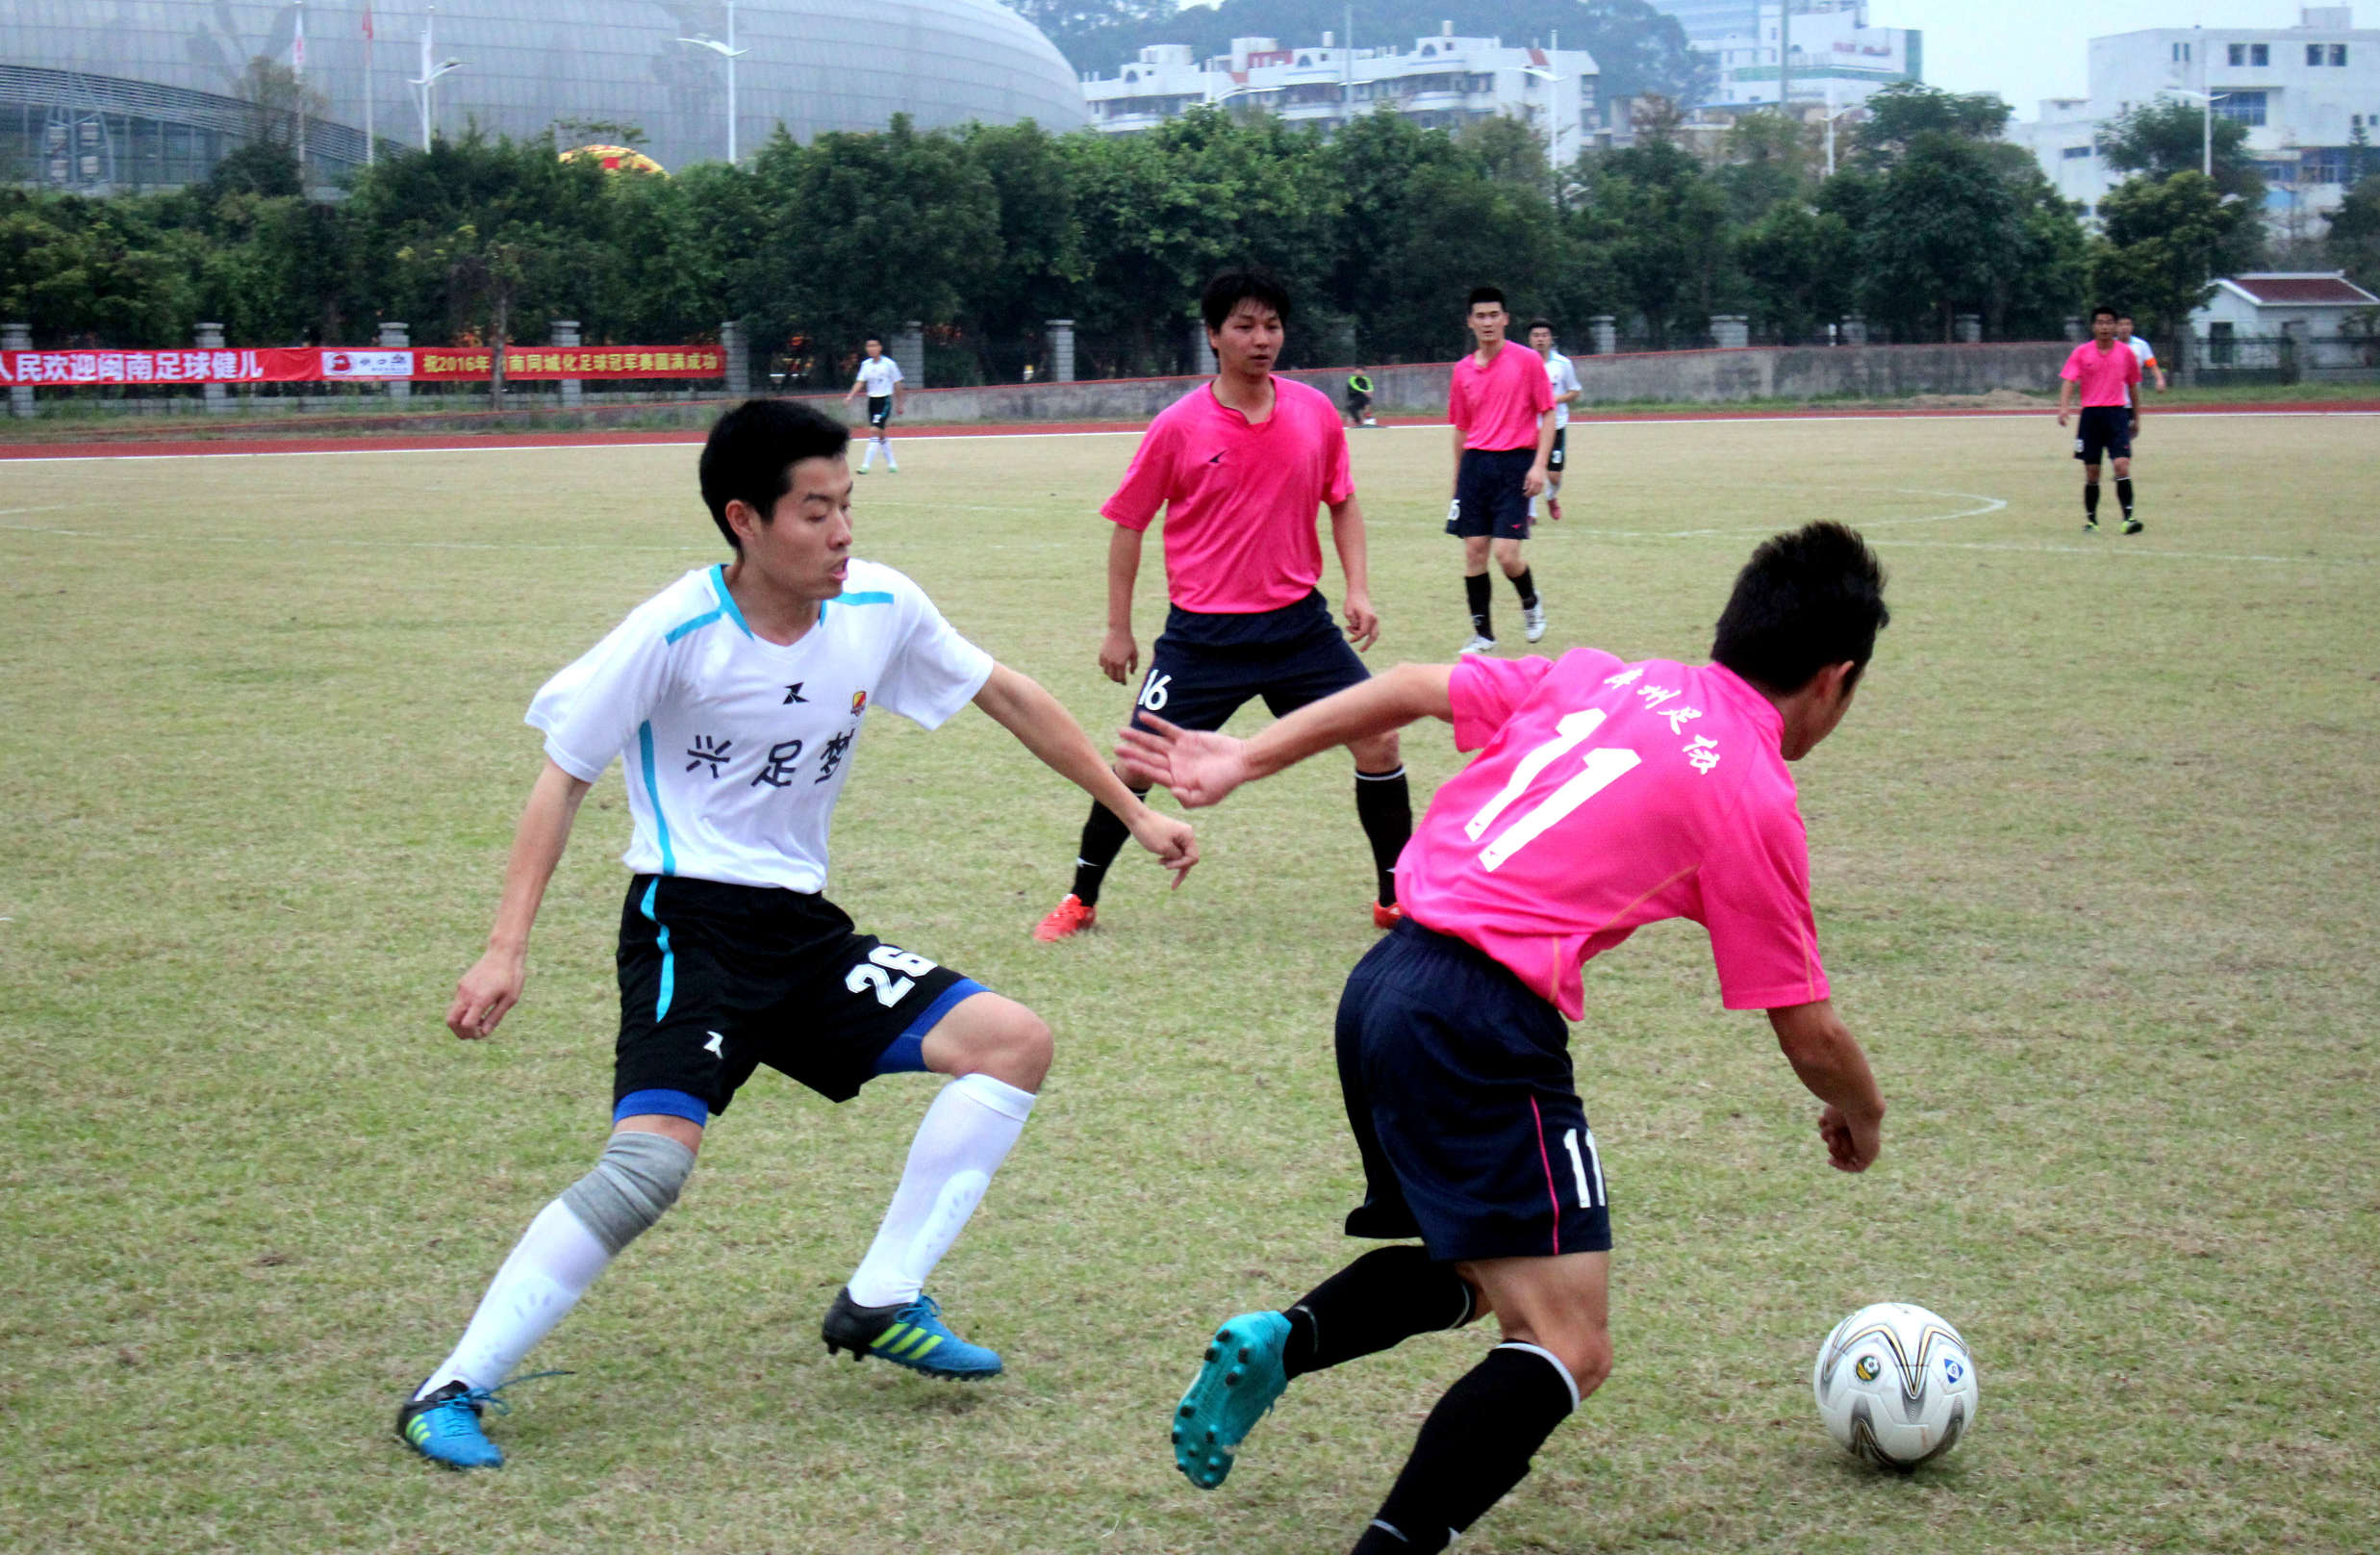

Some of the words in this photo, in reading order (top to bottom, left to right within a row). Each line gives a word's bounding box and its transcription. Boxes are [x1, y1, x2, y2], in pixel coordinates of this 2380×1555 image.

[1138, 669, 1172, 710] 16
[1464, 707, 1642, 873] 11
[845, 946, 939, 1007] 26
[1563, 1128, 1606, 1209] 11
